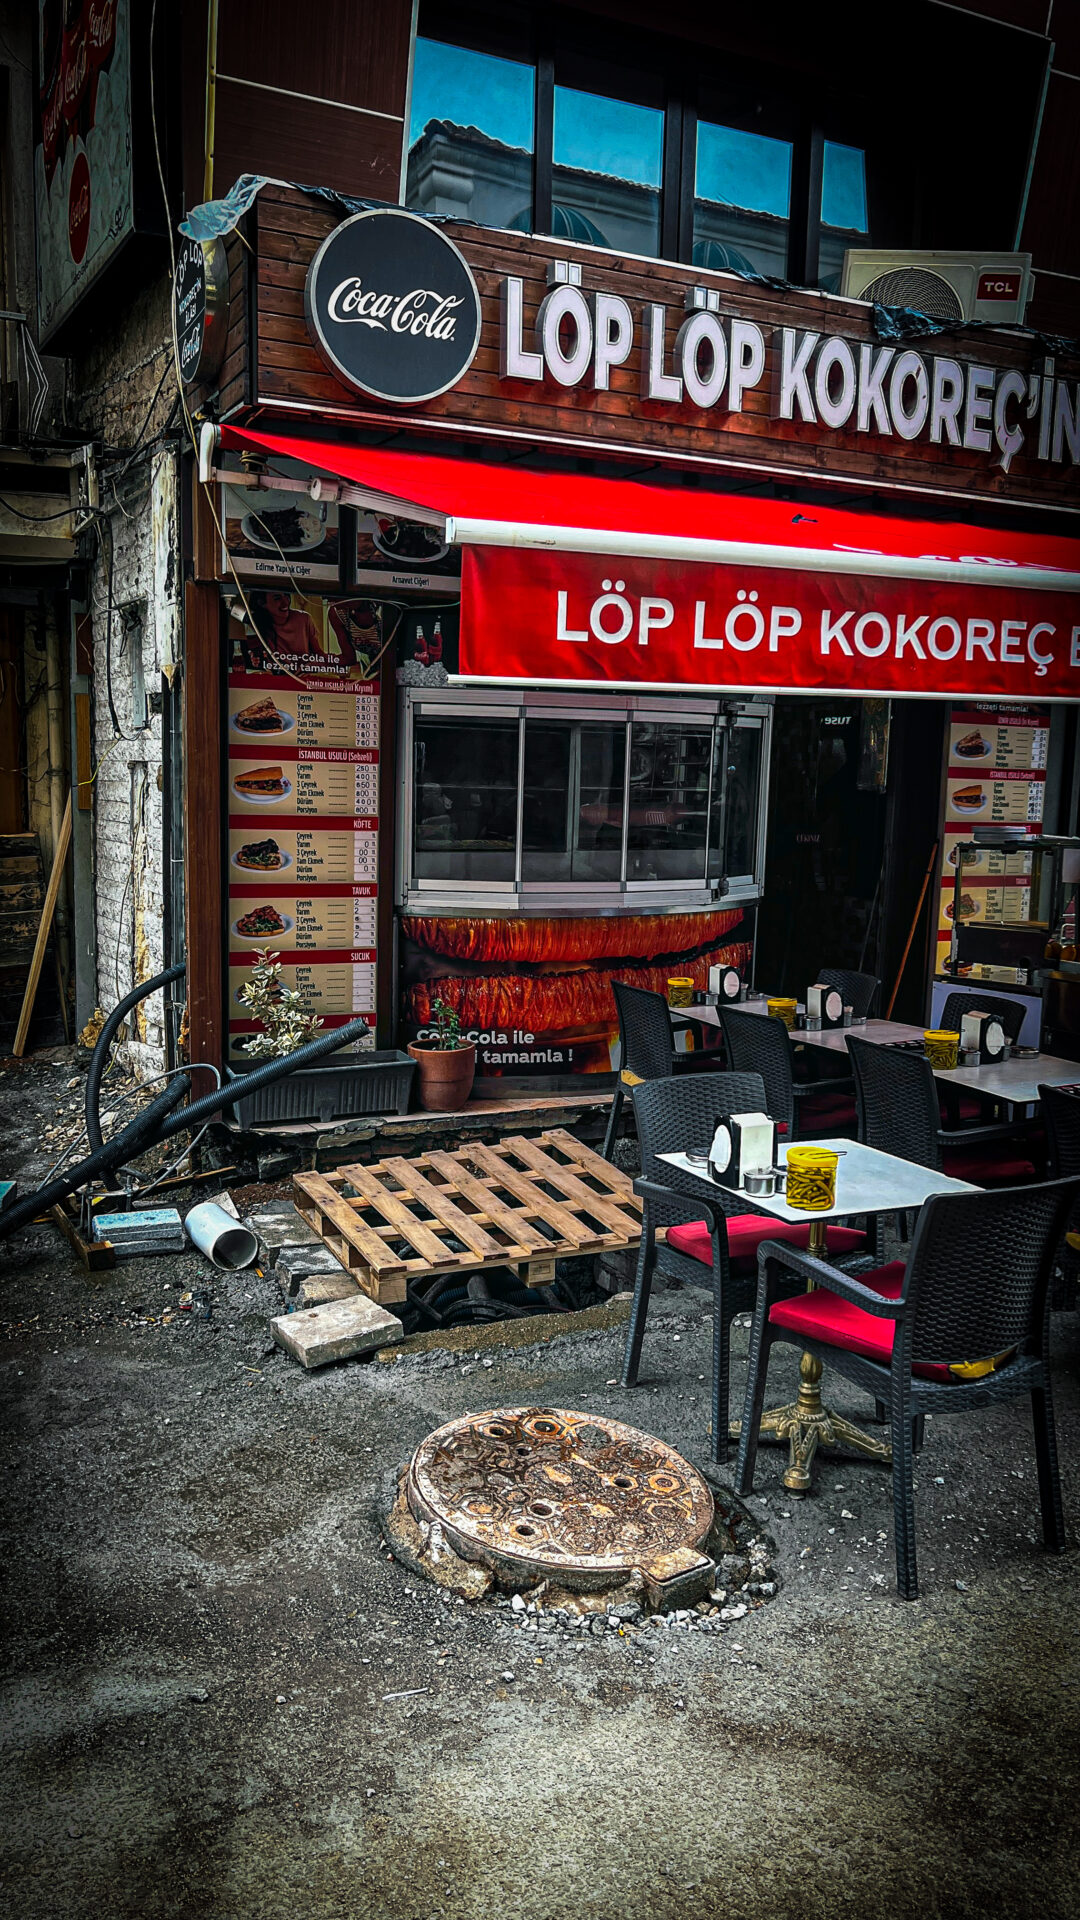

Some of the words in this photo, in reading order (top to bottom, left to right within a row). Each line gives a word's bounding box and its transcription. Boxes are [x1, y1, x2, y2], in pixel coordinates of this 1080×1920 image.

[984, 281, 1014, 294] TCL
[327, 276, 466, 343] Coca-Cola
[502, 259, 634, 391] LÖP
[646, 286, 766, 414] LÖP
[556, 579, 675, 646] LÖP
[693, 589, 802, 653] LÖP
[820, 609, 1056, 677] KOKOREÇ
[272, 651, 325, 663] Coca-Cola
[327, 654, 340, 664] ile
[300, 663, 349, 674] tamamla!
[298, 748, 327, 759] İSTANBUL
[328, 750, 347, 760] USULÜ
[353, 818, 371, 829] KÖFTE
[352, 887, 371, 895] TAVUK
[350, 952, 370, 961] SUCUK
[513, 1030, 535, 1044] ile
[482, 1049, 563, 1064] tamamla
